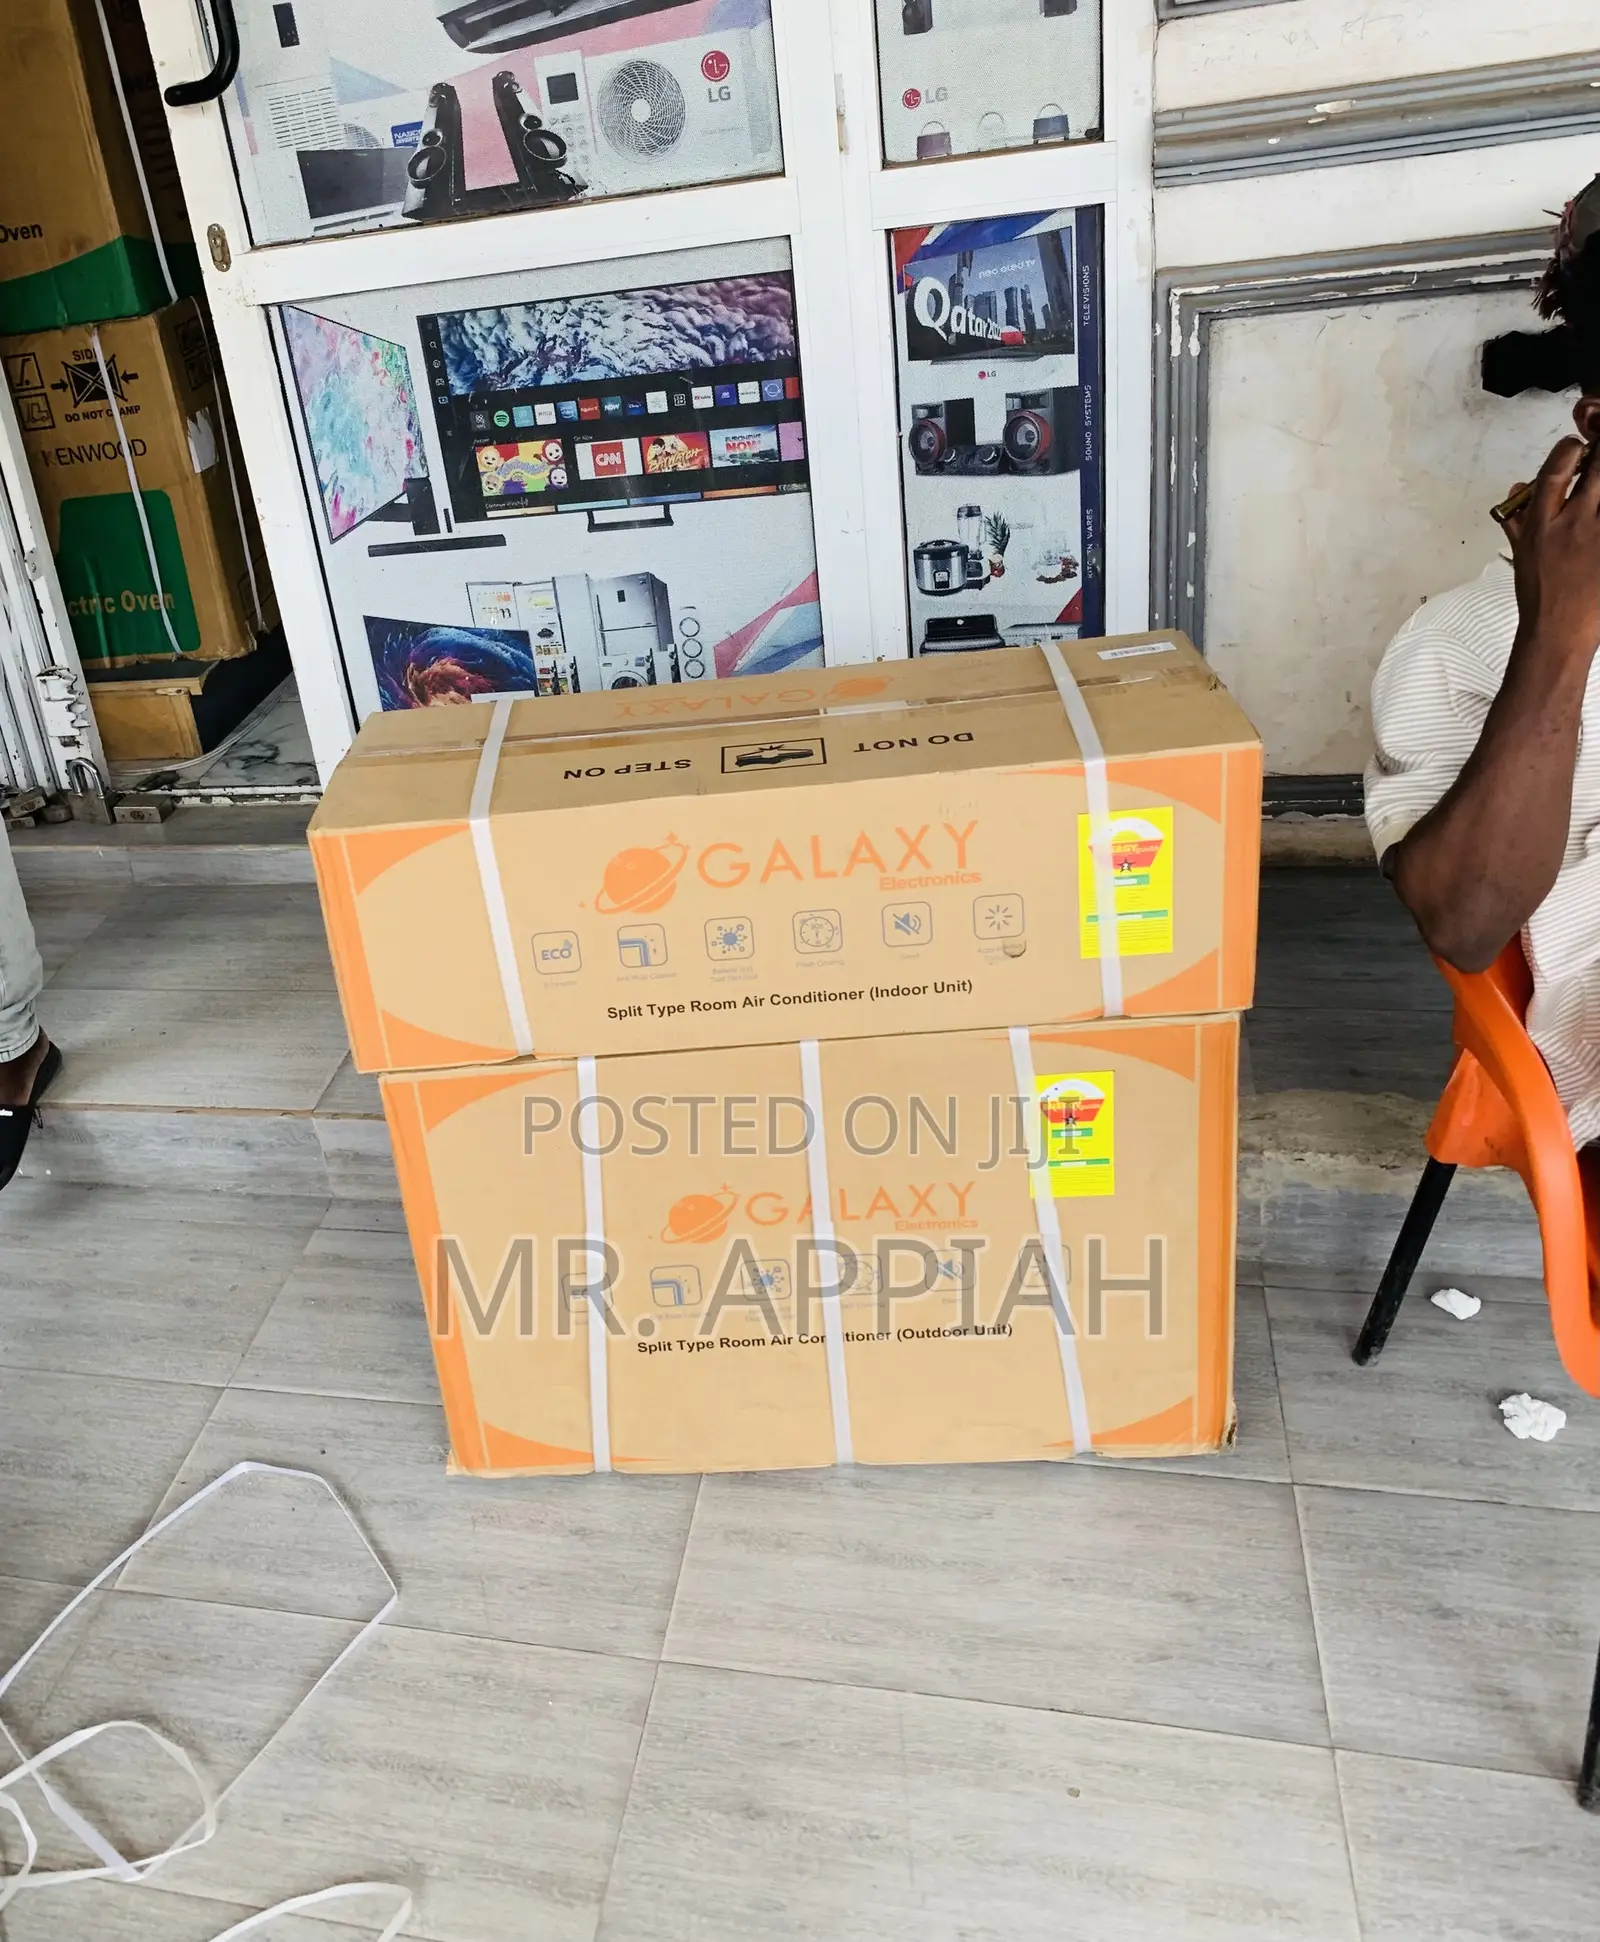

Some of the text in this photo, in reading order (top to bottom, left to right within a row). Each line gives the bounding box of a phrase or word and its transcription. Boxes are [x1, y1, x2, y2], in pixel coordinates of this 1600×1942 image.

[708, 85, 731, 103] LG
[925, 86, 948, 104] LG
[1082, 264, 1091, 327] TELEVISIONS
[72, 348, 99, 361] SID
[987, 370, 997, 378] LG
[65, 405, 141, 423] DO NOT CAMP
[1084, 384, 1093, 461] SOUND SYSTEMS
[595, 451, 622, 467] CNN
[1086, 508, 1094, 540] WARES
[67, 589, 175, 617] ctric Oven
[614, 689, 816, 718] GALAXY
[563, 732, 975, 780] DO NOT STEP ON
[697, 820, 979, 889] GALAXY
[878, 871, 983, 892] Electronics
[541, 947, 572, 962] ECO
[607, 979, 973, 1020] Split Type Room Air Conditioner (Indoor Unit)
[894, 1217, 979, 1232] Electronics
[637, 1341, 673, 1355] Split
[676, 1339, 715, 1353] Type
[719, 1337, 766, 1349] Room
[770, 1334, 794, 1346] Air
[896, 1326, 969, 1343] (Outdoor
[974, 1323, 1013, 1337] Unit)
